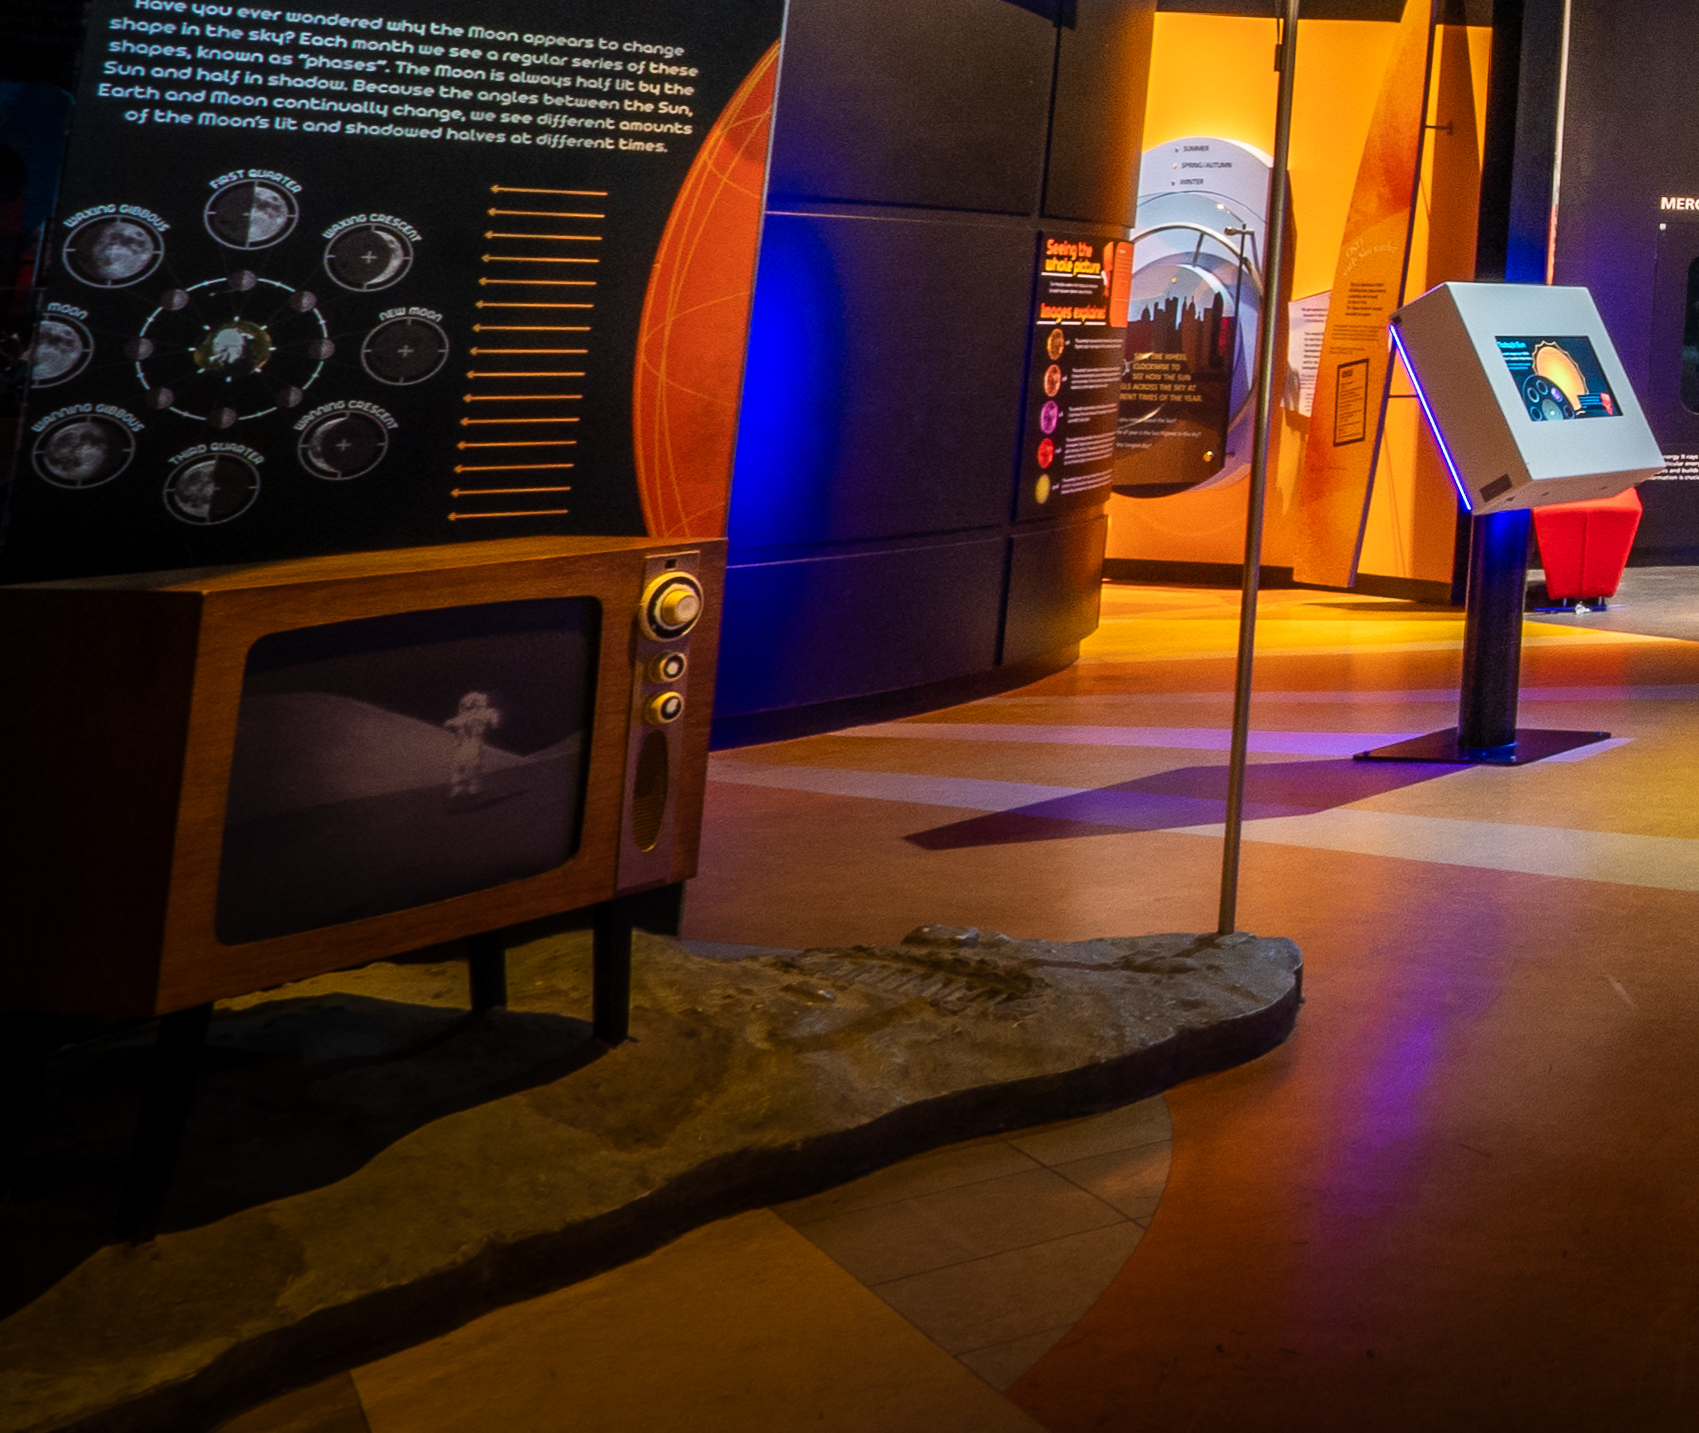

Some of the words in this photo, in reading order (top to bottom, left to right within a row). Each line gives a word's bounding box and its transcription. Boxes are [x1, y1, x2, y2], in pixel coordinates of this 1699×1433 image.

[191, 3, 234, 18] you
[236, 7, 283, 21] ever
[285, 11, 384, 30] wondered
[386, 19, 427, 37] why
[429, 22, 465, 37] the
[467, 25, 520, 42] Moon
[522, 33, 595, 49] appears
[598, 37, 619, 51] to
[622, 40, 685, 59] change
[109, 16, 178, 35] shape
[181, 21, 201, 36] in
[205, 23, 245, 40] the
[248, 28, 296, 46] sky?
[298, 31, 349, 49] Each
[351, 38, 415, 54] month
[418, 44, 446, 57] we
[448, 47, 483, 60] see
[486, 50, 500, 61] a
[502, 51, 569, 67] regular
[570, 57, 624, 71] series
[626, 60, 647, 75] of
[648, 61, 699, 77] these
[124, 108, 151, 125] of
[153, 108, 194, 124] the
[197, 111, 271, 129] Moon's
[274, 116, 299, 131] lit
[302, 120, 342, 133] and
[344, 121, 443, 140] shadowed
[445, 127, 507, 143] halves
[510, 131, 533, 145] at
[535, 133, 616, 150] different
[618, 137, 668, 153] times.
[209, 169, 245, 188] FIRST
[248, 168, 303, 193] QUARTER
[63, 204, 117, 228] WAXING
[119, 204, 171, 232] GIBBOUS
[321, 213, 368, 239] WAXING
[369, 213, 423, 242] CRESCENT
[1046, 238, 1078, 261] Seeing
[1078, 241, 1094, 258] the
[1045, 256, 1073, 272] whole
[167, 444, 207, 465] THIRD
[210, 442, 265, 465] QUARTER
